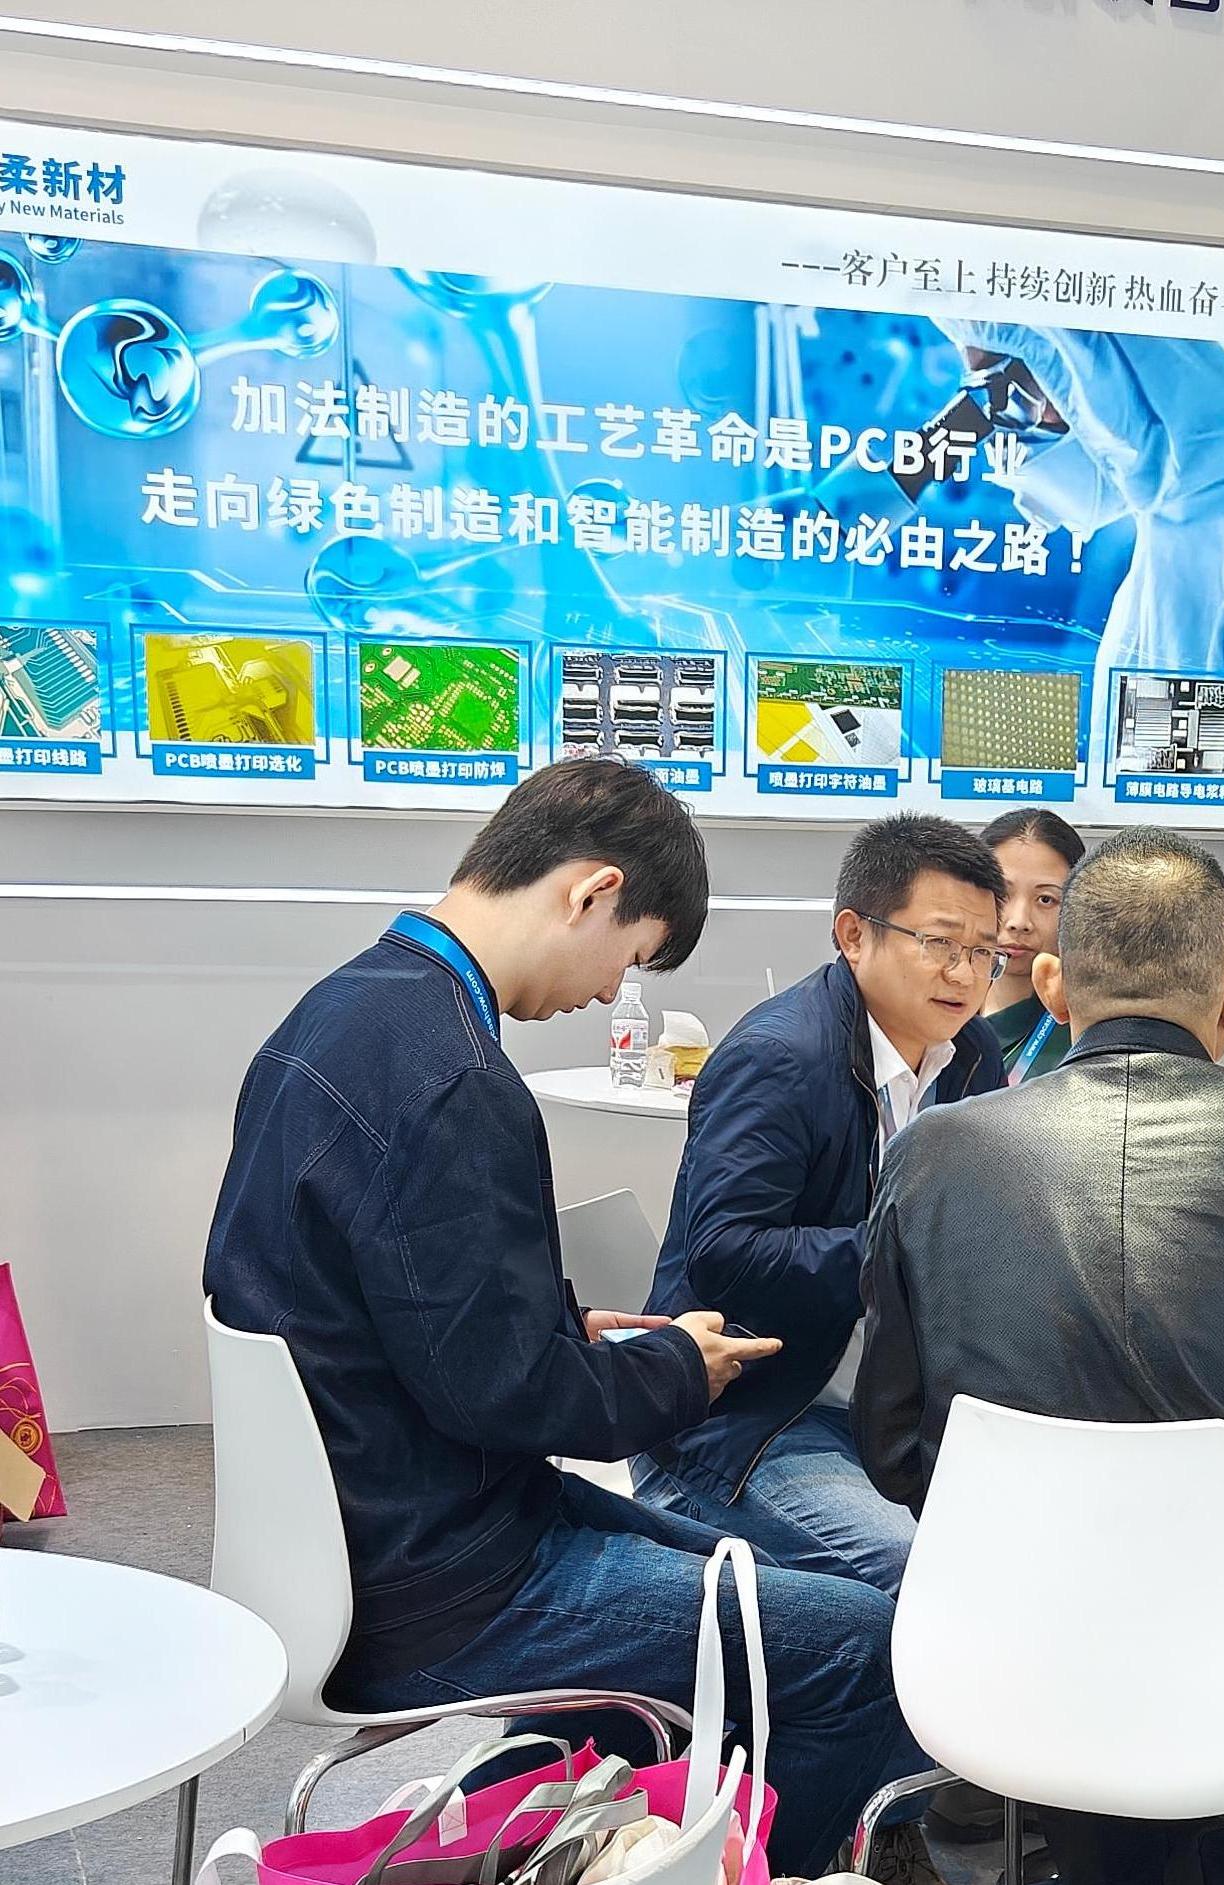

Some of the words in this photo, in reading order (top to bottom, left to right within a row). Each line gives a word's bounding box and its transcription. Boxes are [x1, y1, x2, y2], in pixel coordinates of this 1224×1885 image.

[0, 153, 126, 204] 柔新材
[10, 200, 46, 216] New
[50, 205, 125, 225] Materials
[987, 262, 1116, 308] 持续创新
[230, 375, 1030, 483] 加法制造的工艺革命是PCB行业
[973, 777, 1043, 795] 玻璃基电路
